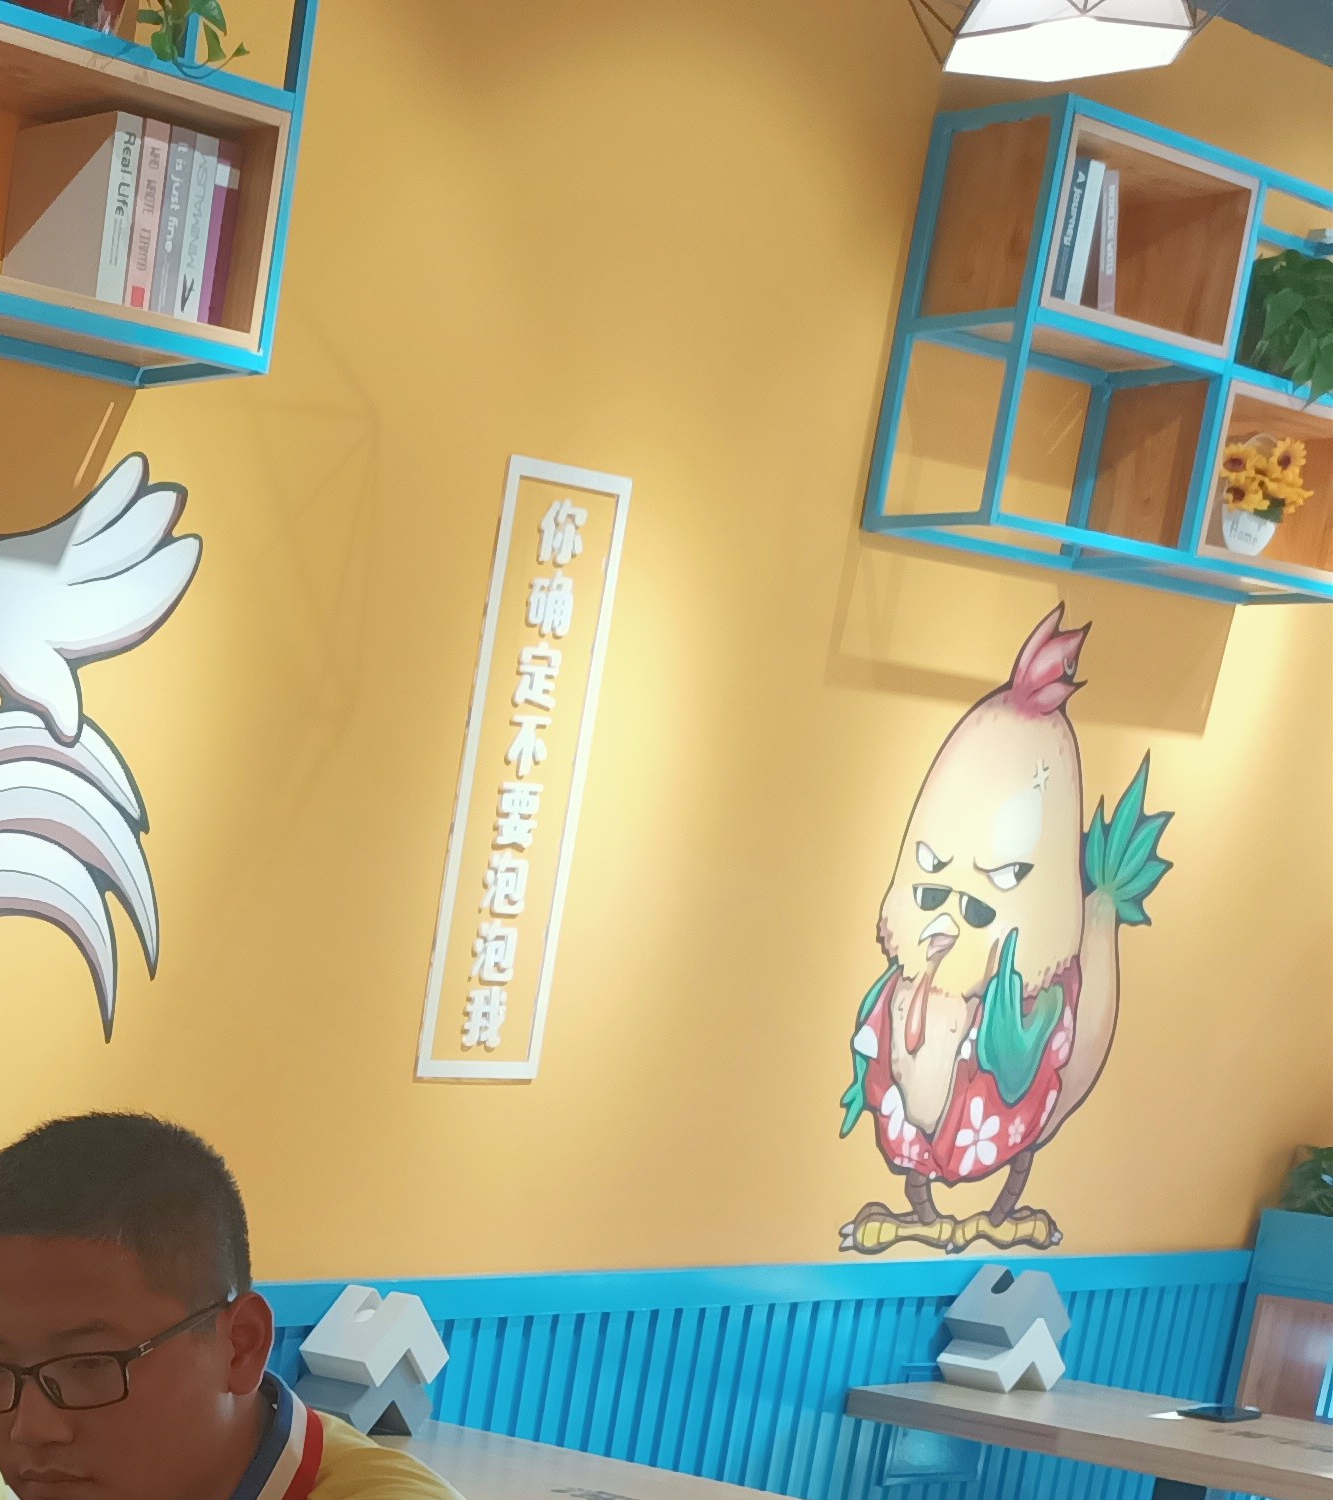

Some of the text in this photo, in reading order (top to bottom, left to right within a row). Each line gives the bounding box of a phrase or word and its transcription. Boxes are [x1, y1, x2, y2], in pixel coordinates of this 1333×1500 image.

[120, 131, 137, 176] Real
[115, 181, 131, 216] Life
[170, 174, 184, 211] just
[164, 216, 179, 253] fine
